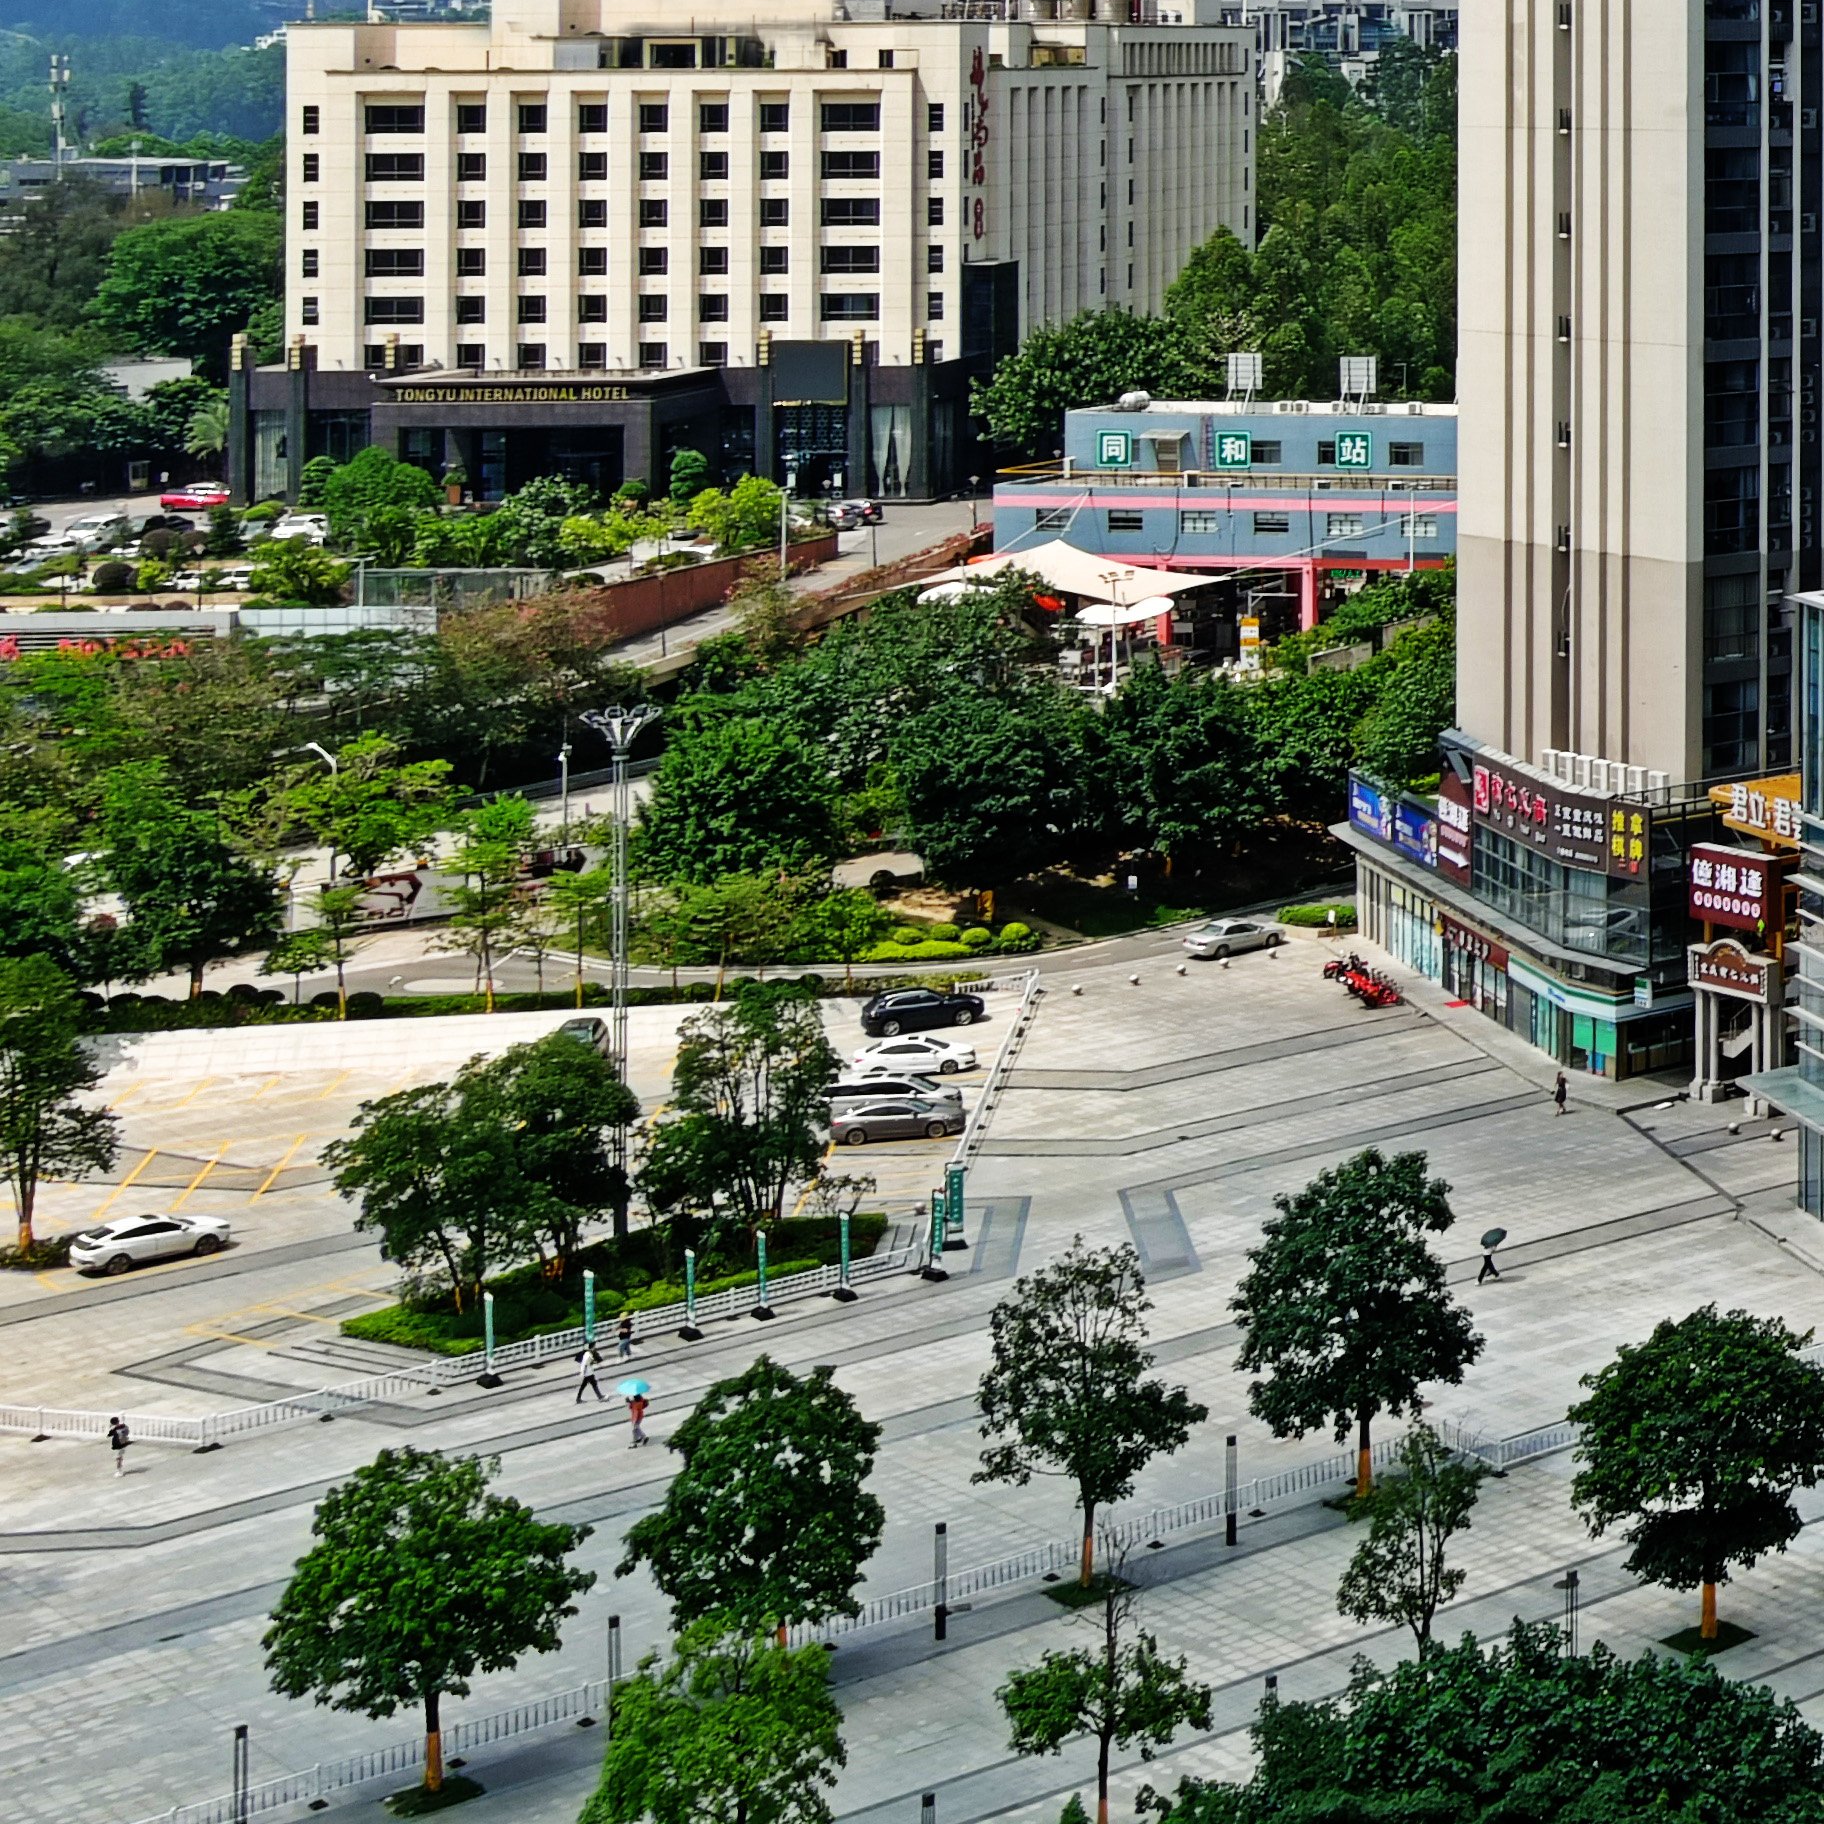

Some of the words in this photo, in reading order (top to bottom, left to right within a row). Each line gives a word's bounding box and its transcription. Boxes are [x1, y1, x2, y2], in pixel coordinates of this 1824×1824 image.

[395, 388, 456, 402] TONGYU
[459, 387, 578, 402] INTERNATIONAL
[581, 386, 631, 401] HOTEL
